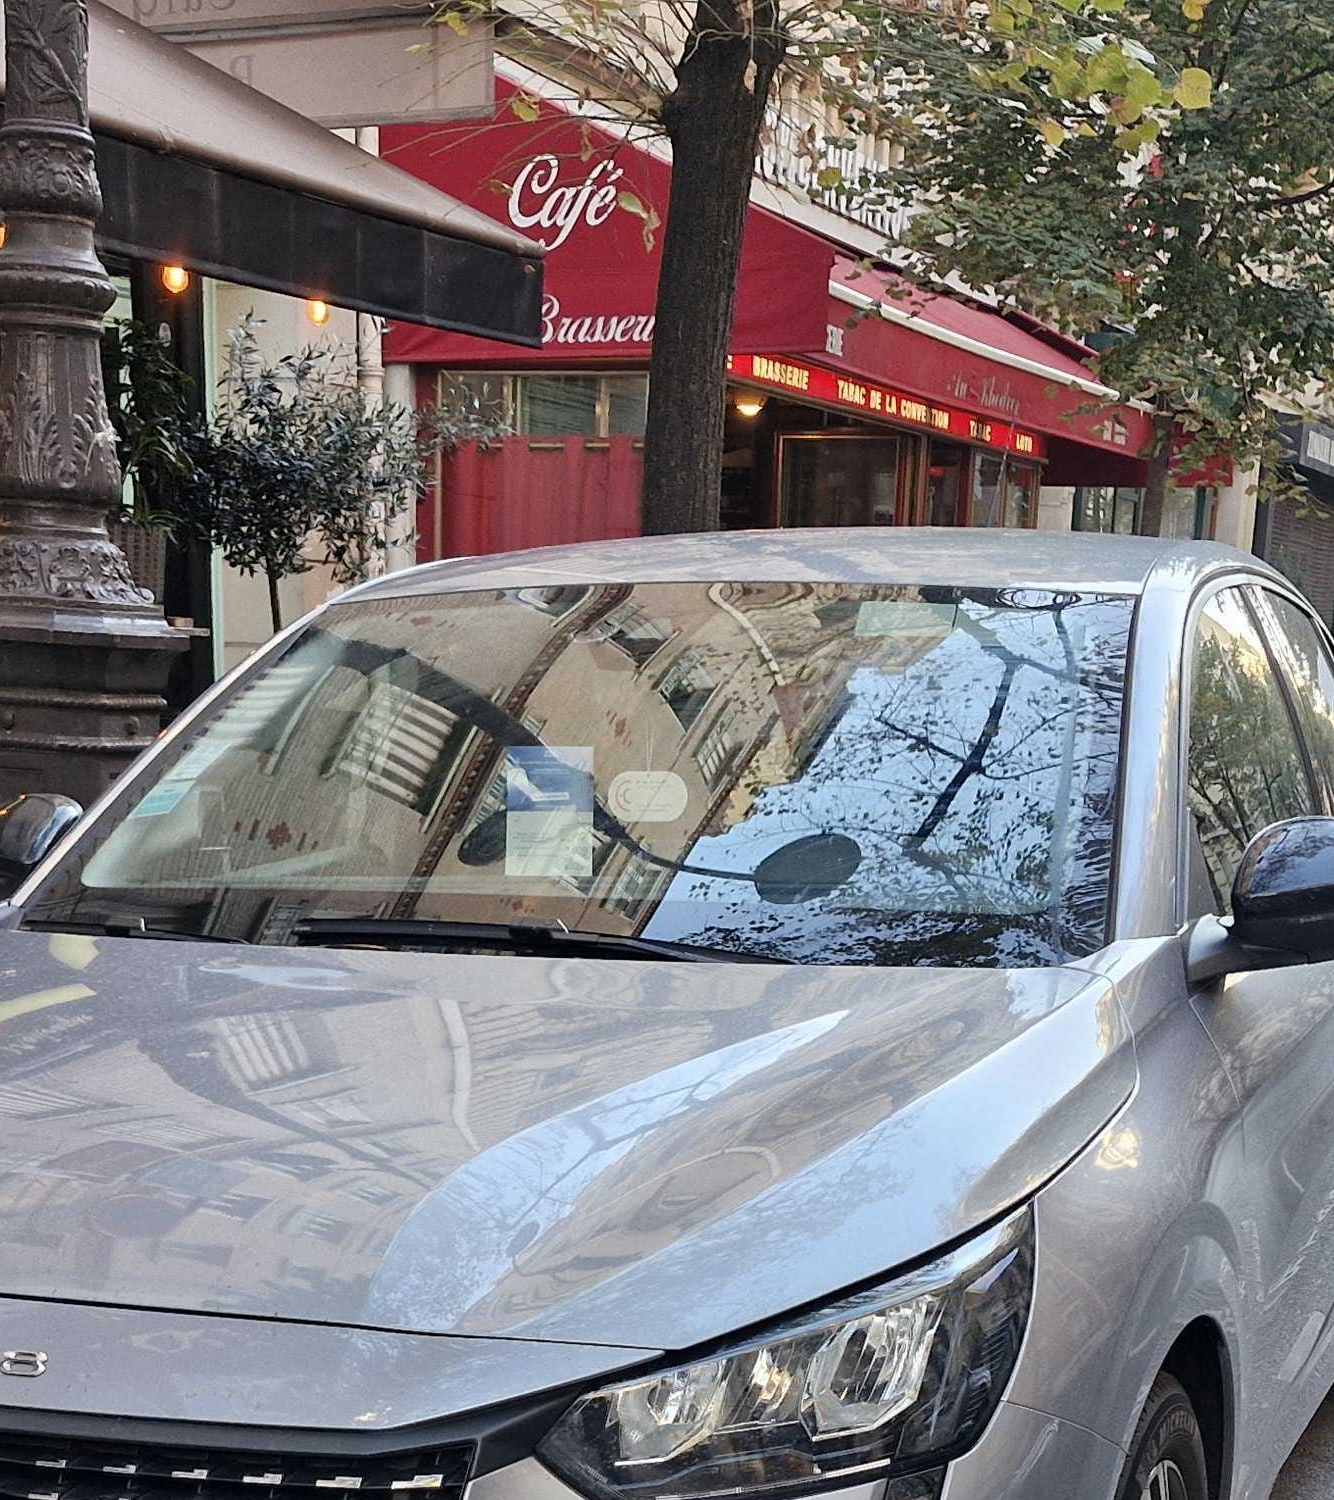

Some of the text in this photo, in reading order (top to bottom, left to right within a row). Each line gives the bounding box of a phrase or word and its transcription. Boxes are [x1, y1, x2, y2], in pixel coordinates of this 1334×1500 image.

[508, 153, 624, 251] Café
[541, 293, 657, 344] Brasseri
[752, 356, 809, 391] BRASSERIE
[837, 379, 866, 406] TABAC
[869, 390, 882, 410] DE
[885, 394, 897, 416] LA
[1016, 433, 1034, 453] LOTO
